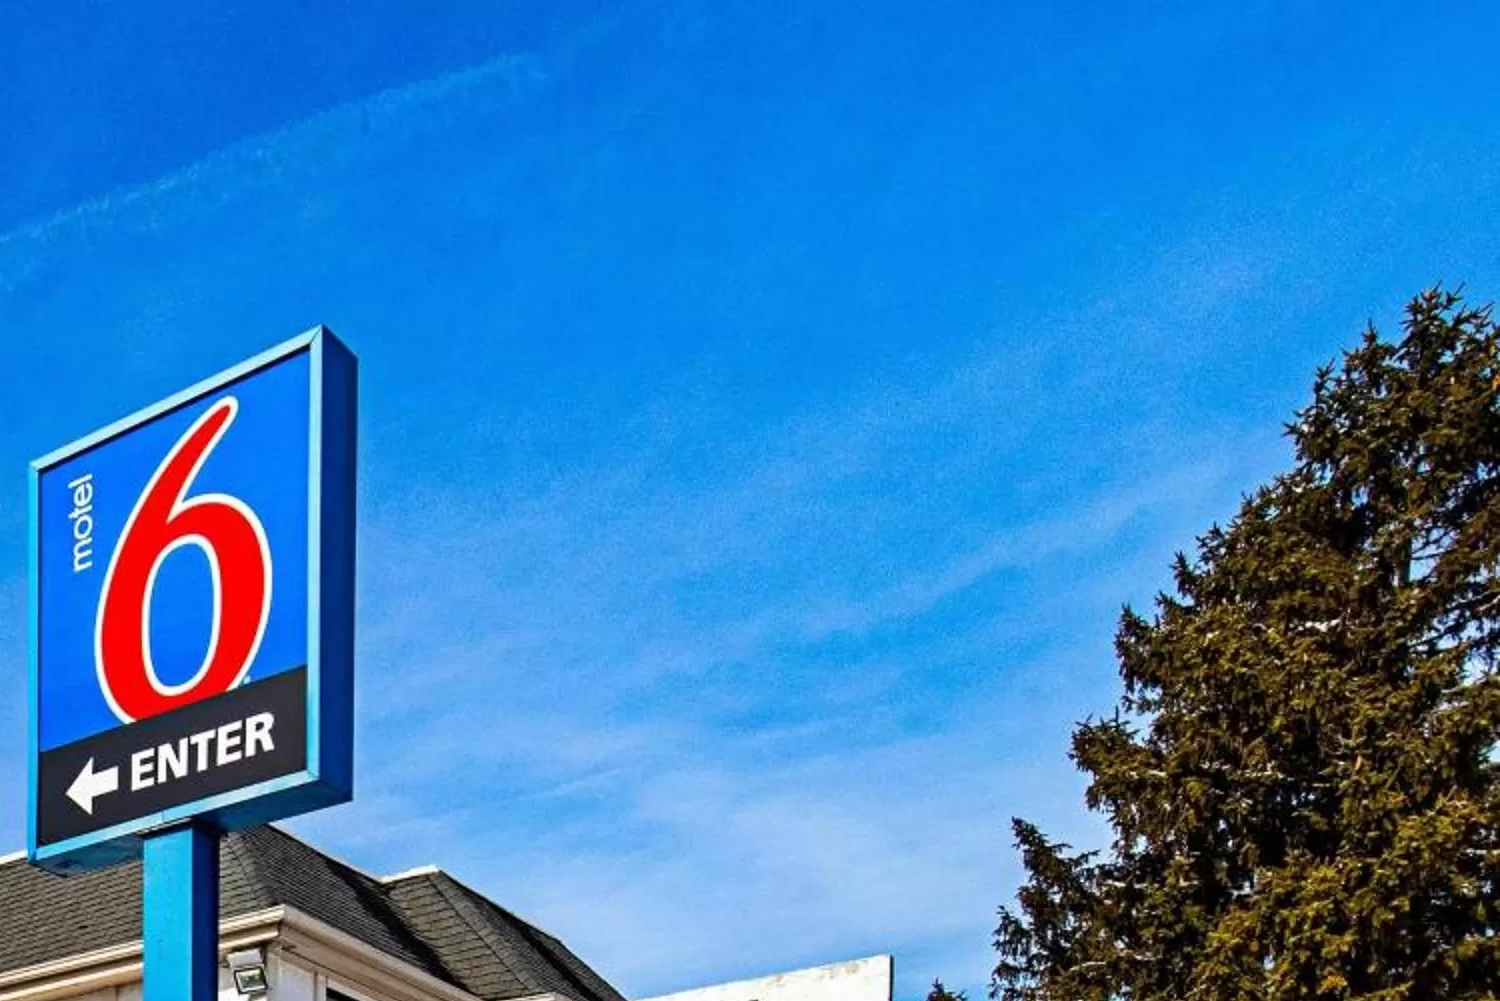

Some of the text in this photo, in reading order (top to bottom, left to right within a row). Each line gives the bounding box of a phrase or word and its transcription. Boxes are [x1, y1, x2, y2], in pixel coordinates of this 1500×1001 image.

[67, 473, 93, 572] motel
[94, 396, 272, 724] 6
[131, 711, 275, 792] ENTER
